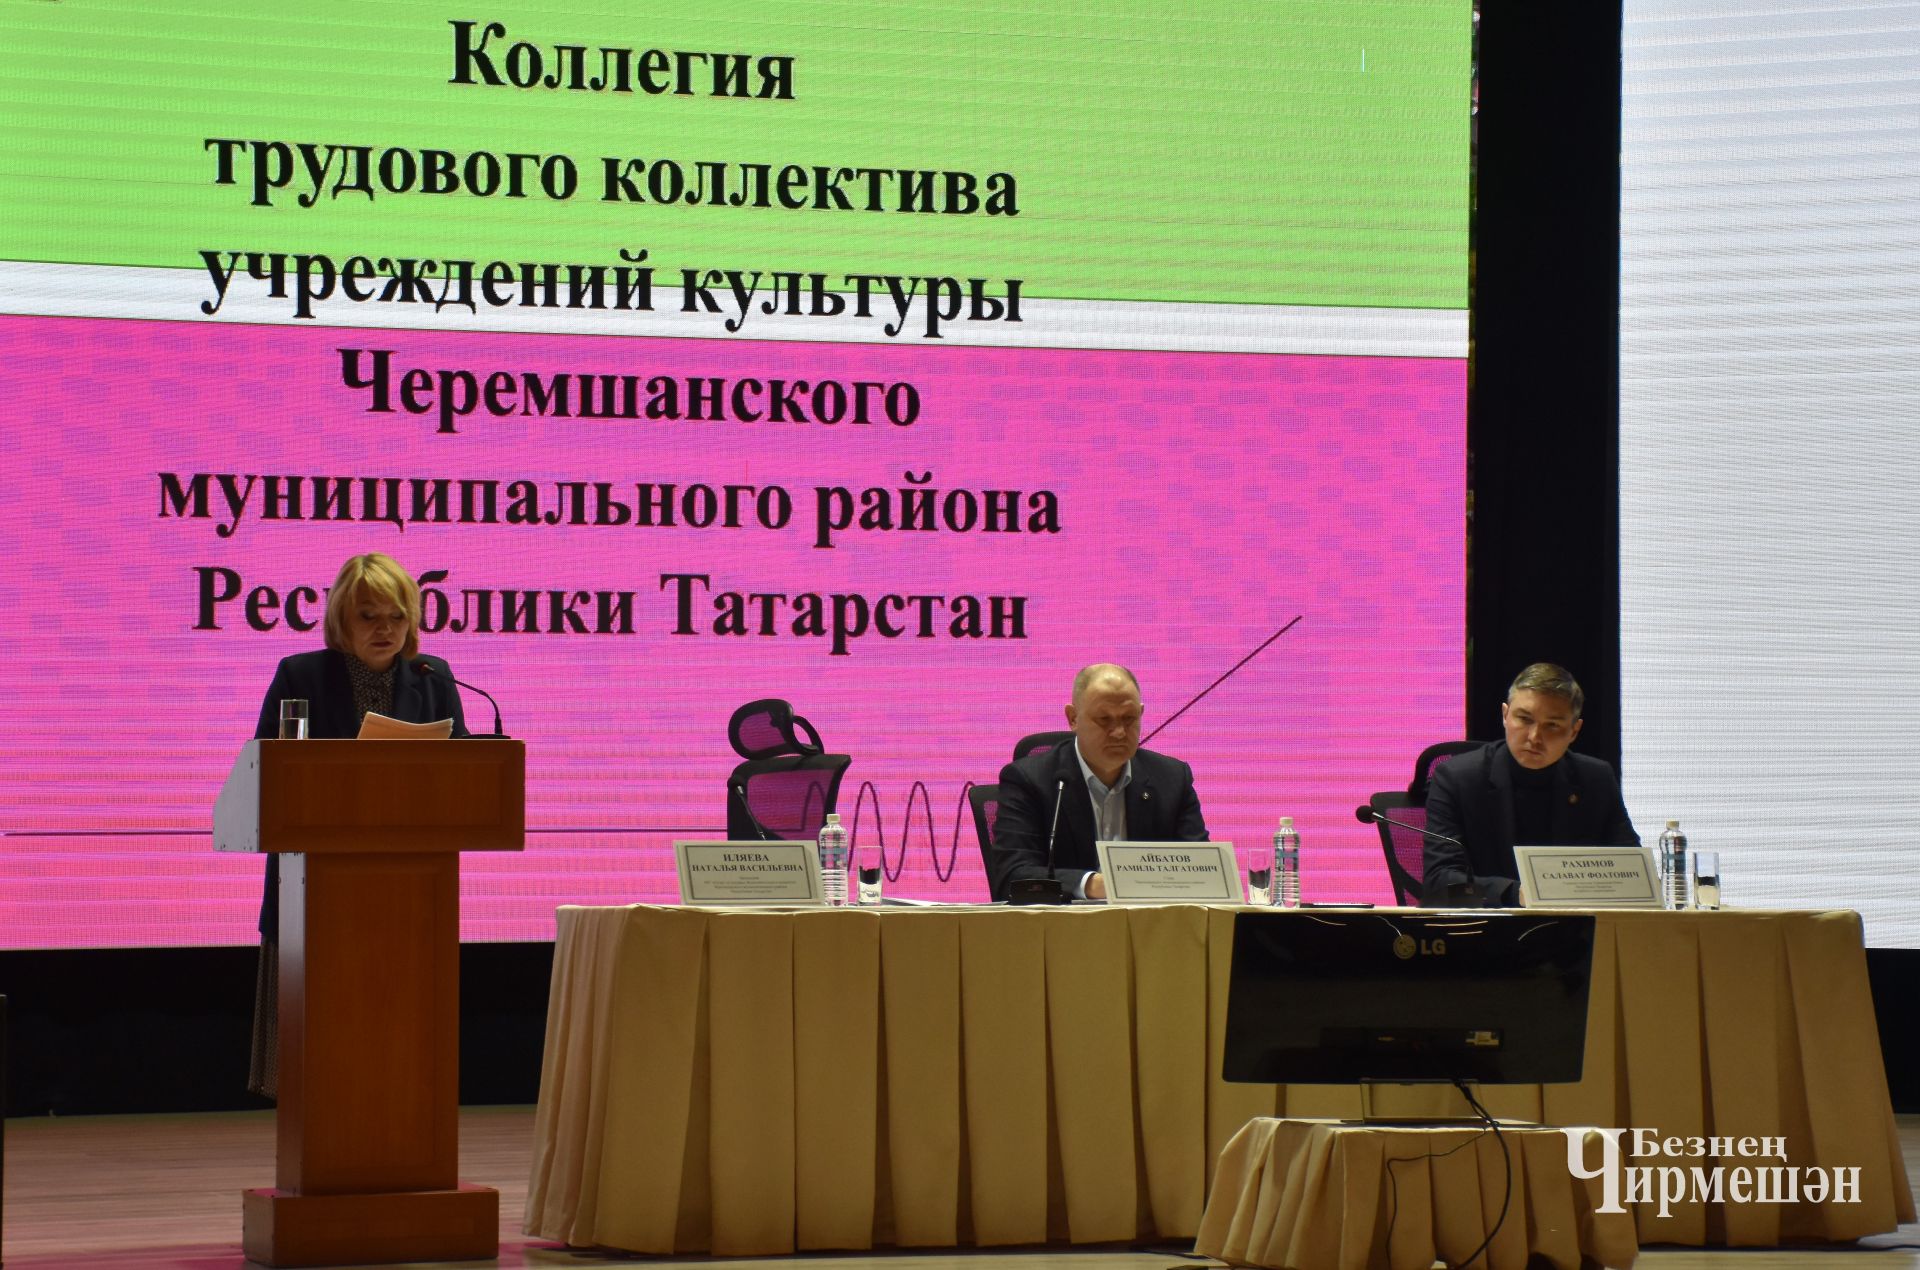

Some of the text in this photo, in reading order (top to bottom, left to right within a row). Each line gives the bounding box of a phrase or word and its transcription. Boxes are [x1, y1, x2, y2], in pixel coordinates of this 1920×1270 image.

[447, 20, 796, 100] Коллегия
[204, 138, 1020, 217] трудового коллектива
[199, 249, 1024, 339] учреждений культуры
[337, 348, 921, 434] Черемшанского
[158, 470, 1062, 548] муниципального района
[191, 566, 1028, 656] Ресблики Татарстан
[692, 864, 803, 872] НАТАЛЬЯ ВАСИЛЬЕВНА
[1140, 853, 1191, 863] АЙБАТОВ
[1562, 860, 1615, 868] РАХИМОВ
[1587, 871, 1639, 879] ФОАТОВИЧ
[1421, 938, 1446, 956] LG
